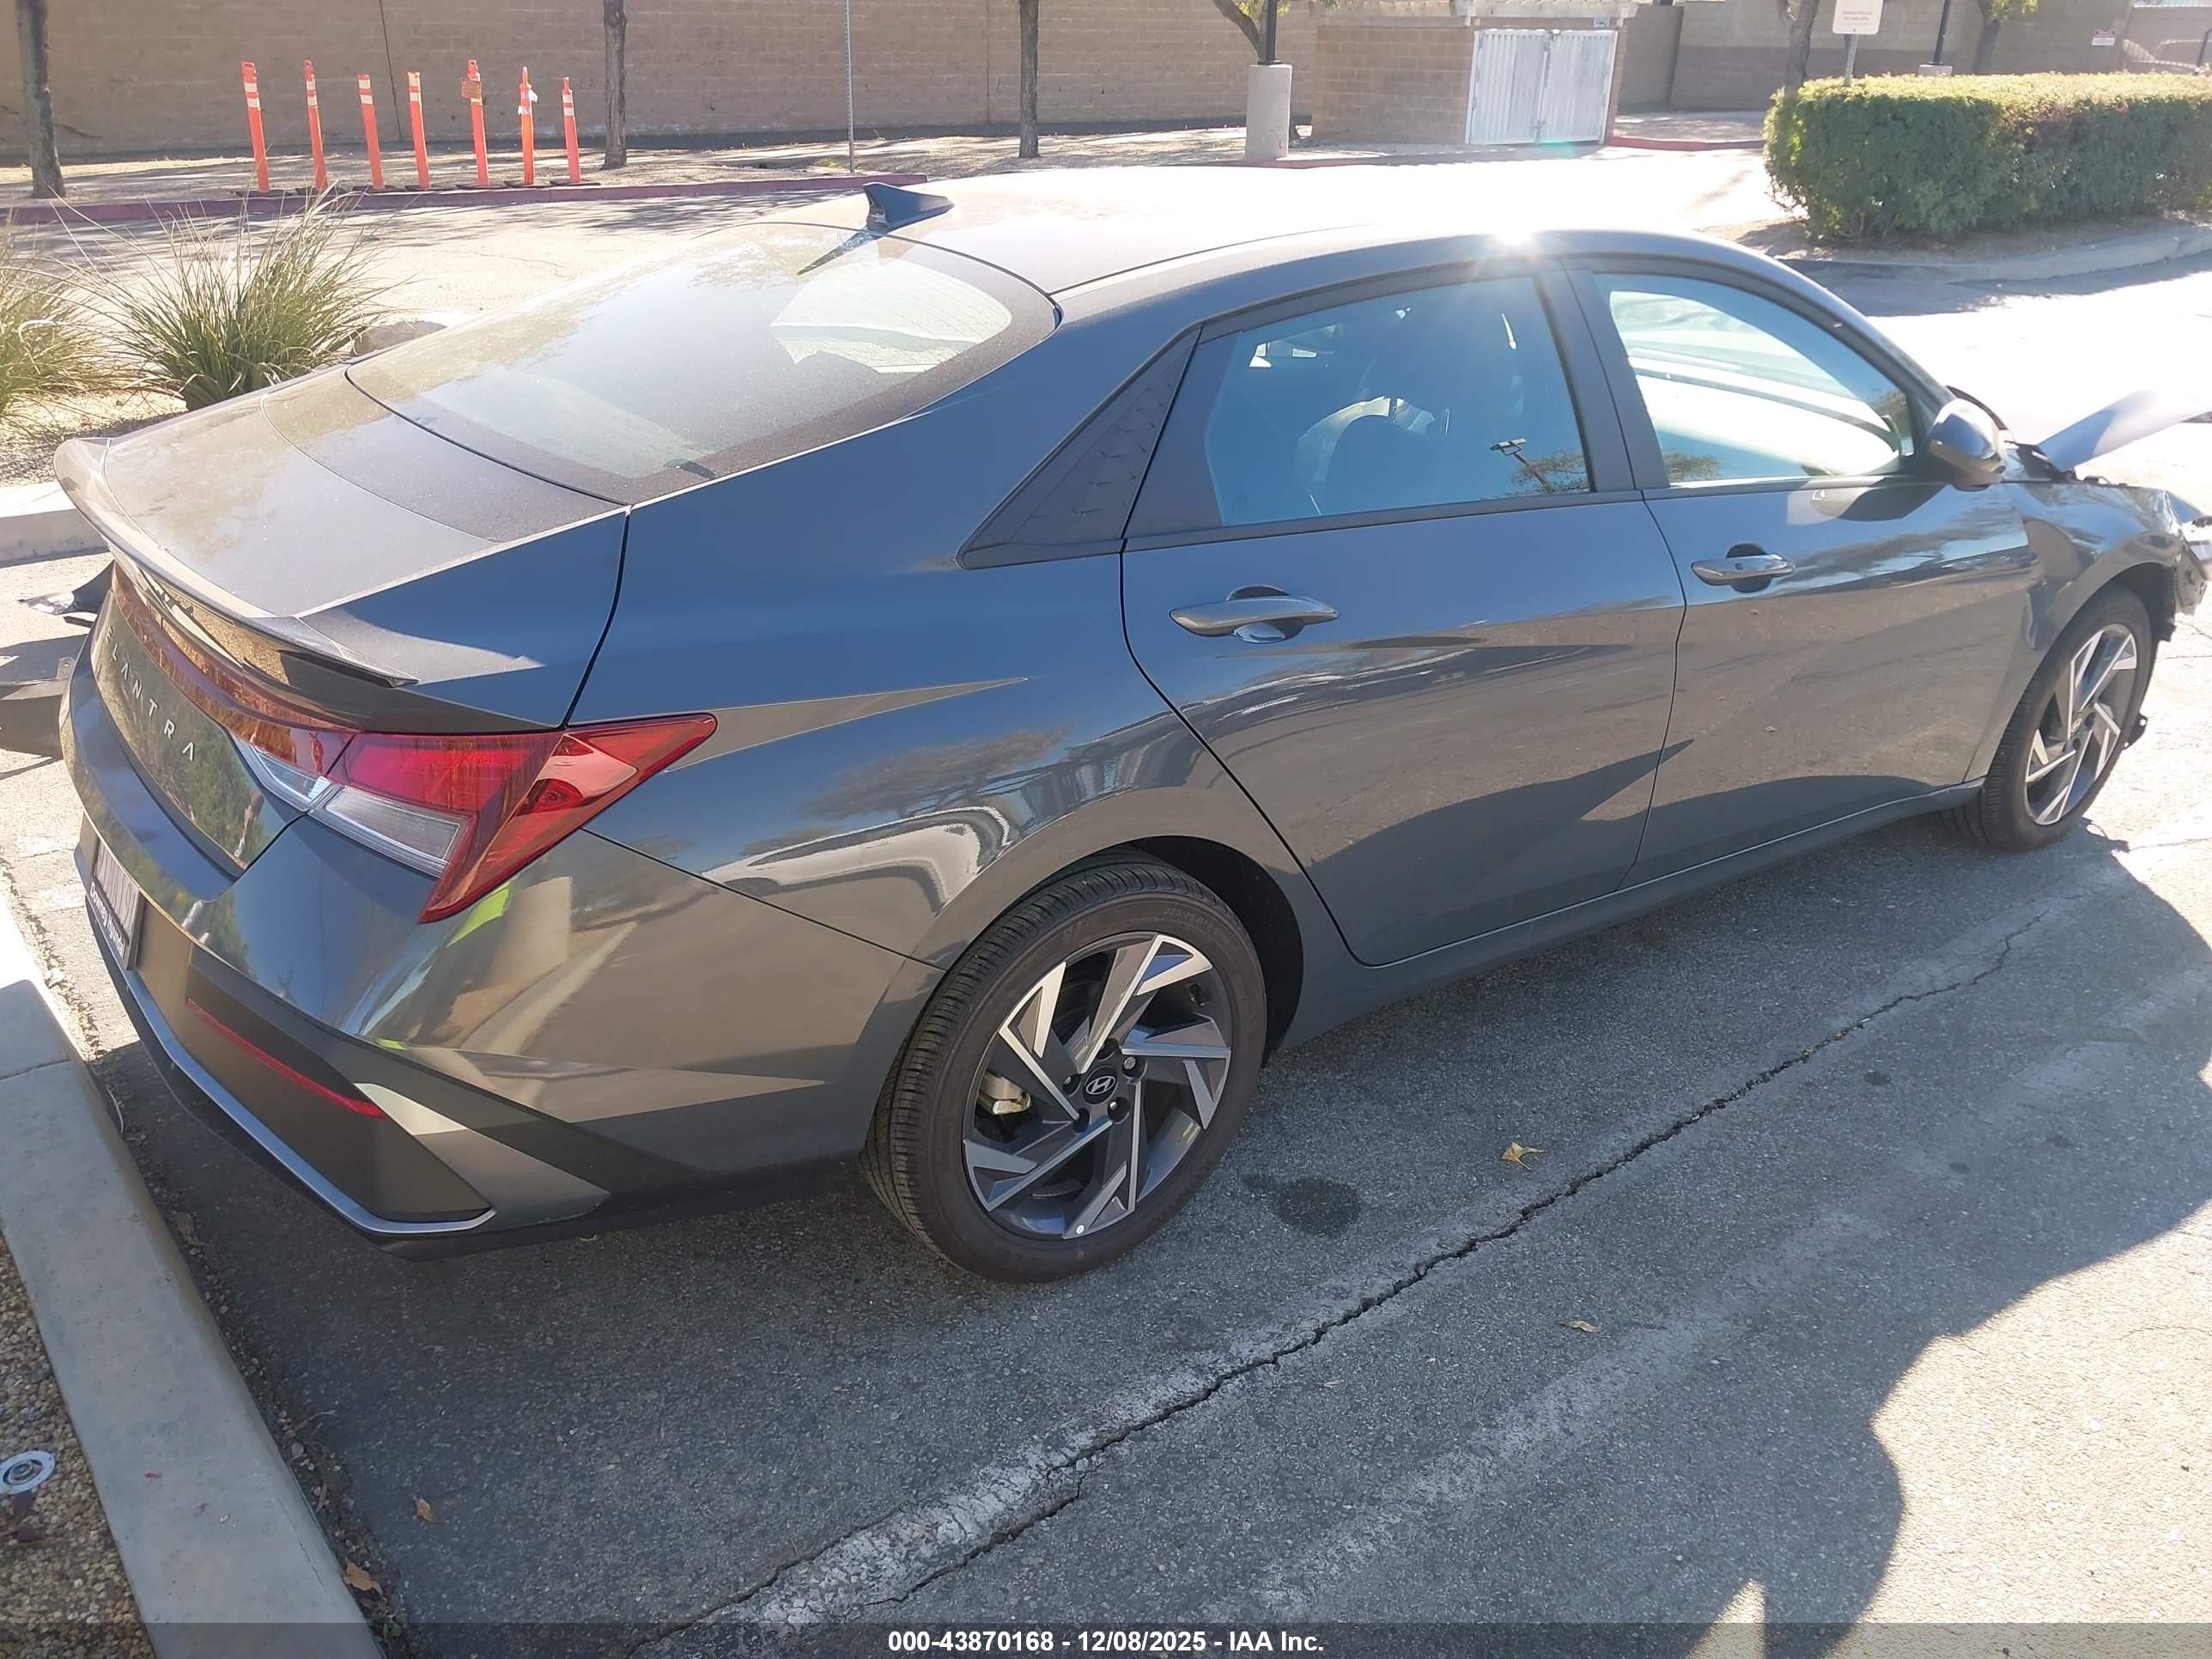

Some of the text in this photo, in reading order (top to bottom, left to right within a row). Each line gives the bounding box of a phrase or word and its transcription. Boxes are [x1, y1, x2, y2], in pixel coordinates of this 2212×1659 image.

[106, 626, 195, 762] ELANTRA
[89, 880, 126, 959] Downey Hyundai
